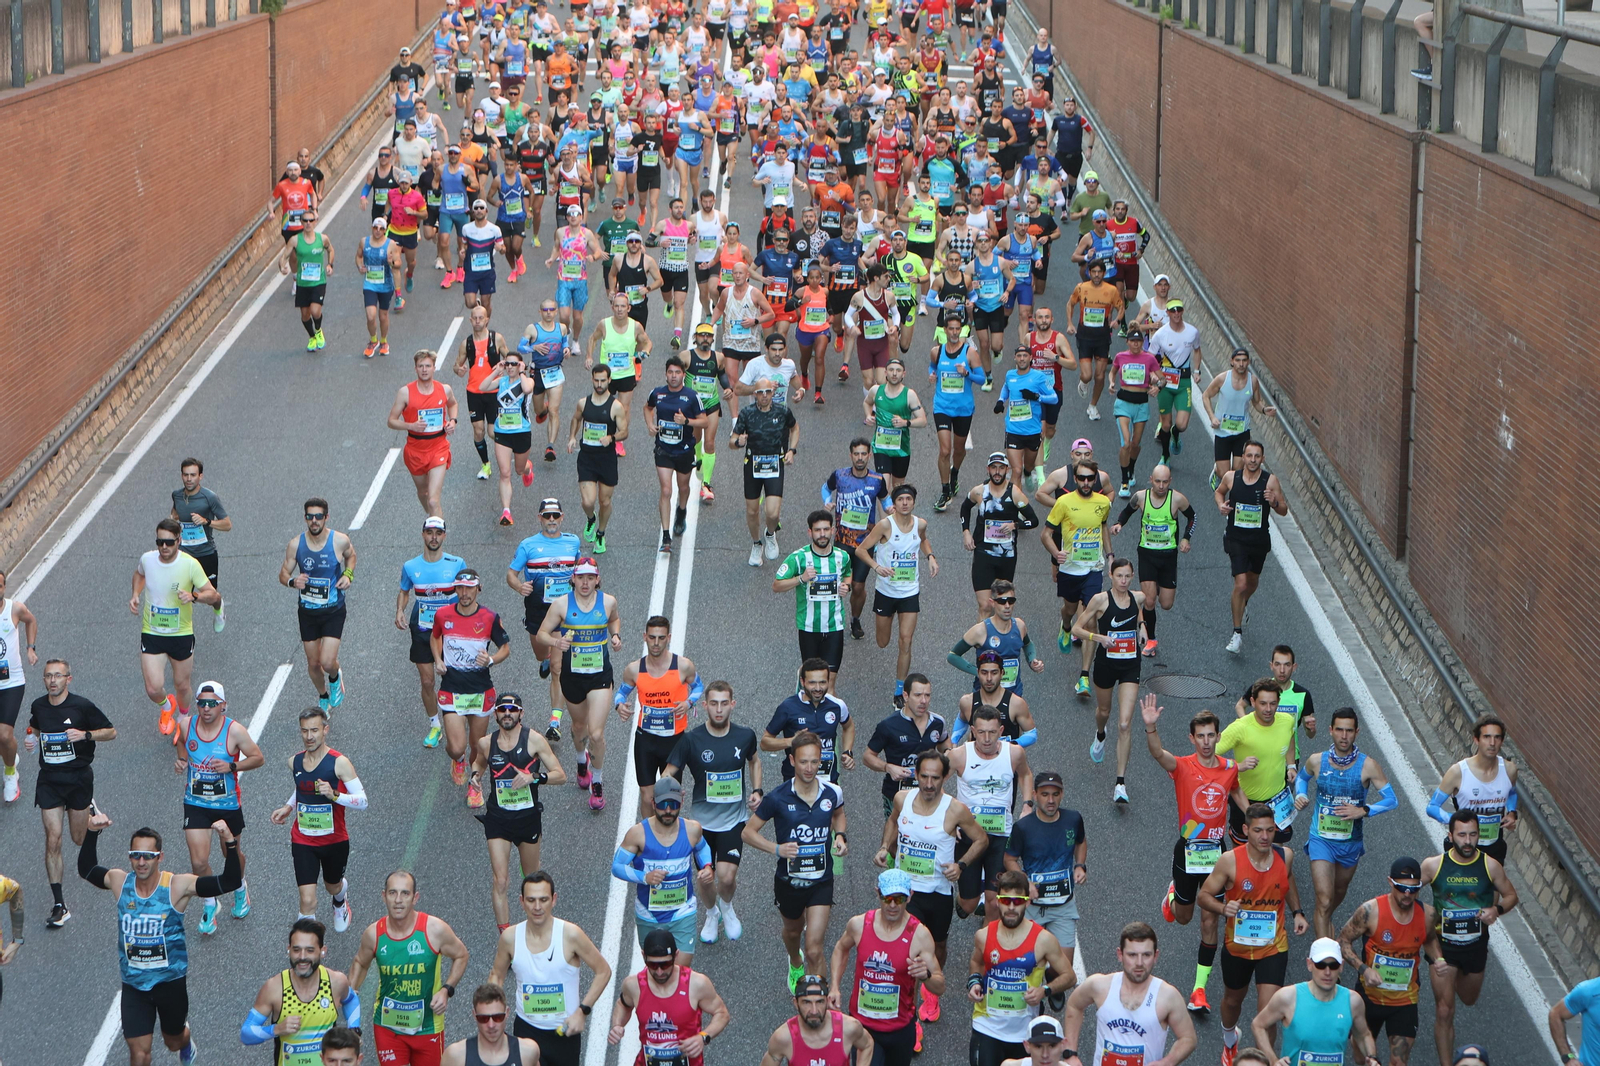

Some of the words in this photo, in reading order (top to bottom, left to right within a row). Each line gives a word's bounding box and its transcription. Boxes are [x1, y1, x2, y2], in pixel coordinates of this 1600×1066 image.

[910, 848, 932, 858] ZURICH
[1045, 872, 1064, 881] ZURICH
[1446, 876, 1478, 884] CONFINES
[664, 881, 684, 889] ZURICH
[864, 970, 875, 978] LOS
[876, 972, 894, 982] LUNES
[990, 968, 1026, 980] PALACIEGO
[872, 986, 894, 994] ZURICH
[1106, 1018, 1148, 1037] PHOENIX
[295, 1044, 320, 1052] ZURICH
[298, 1057, 312, 1066] 1794
